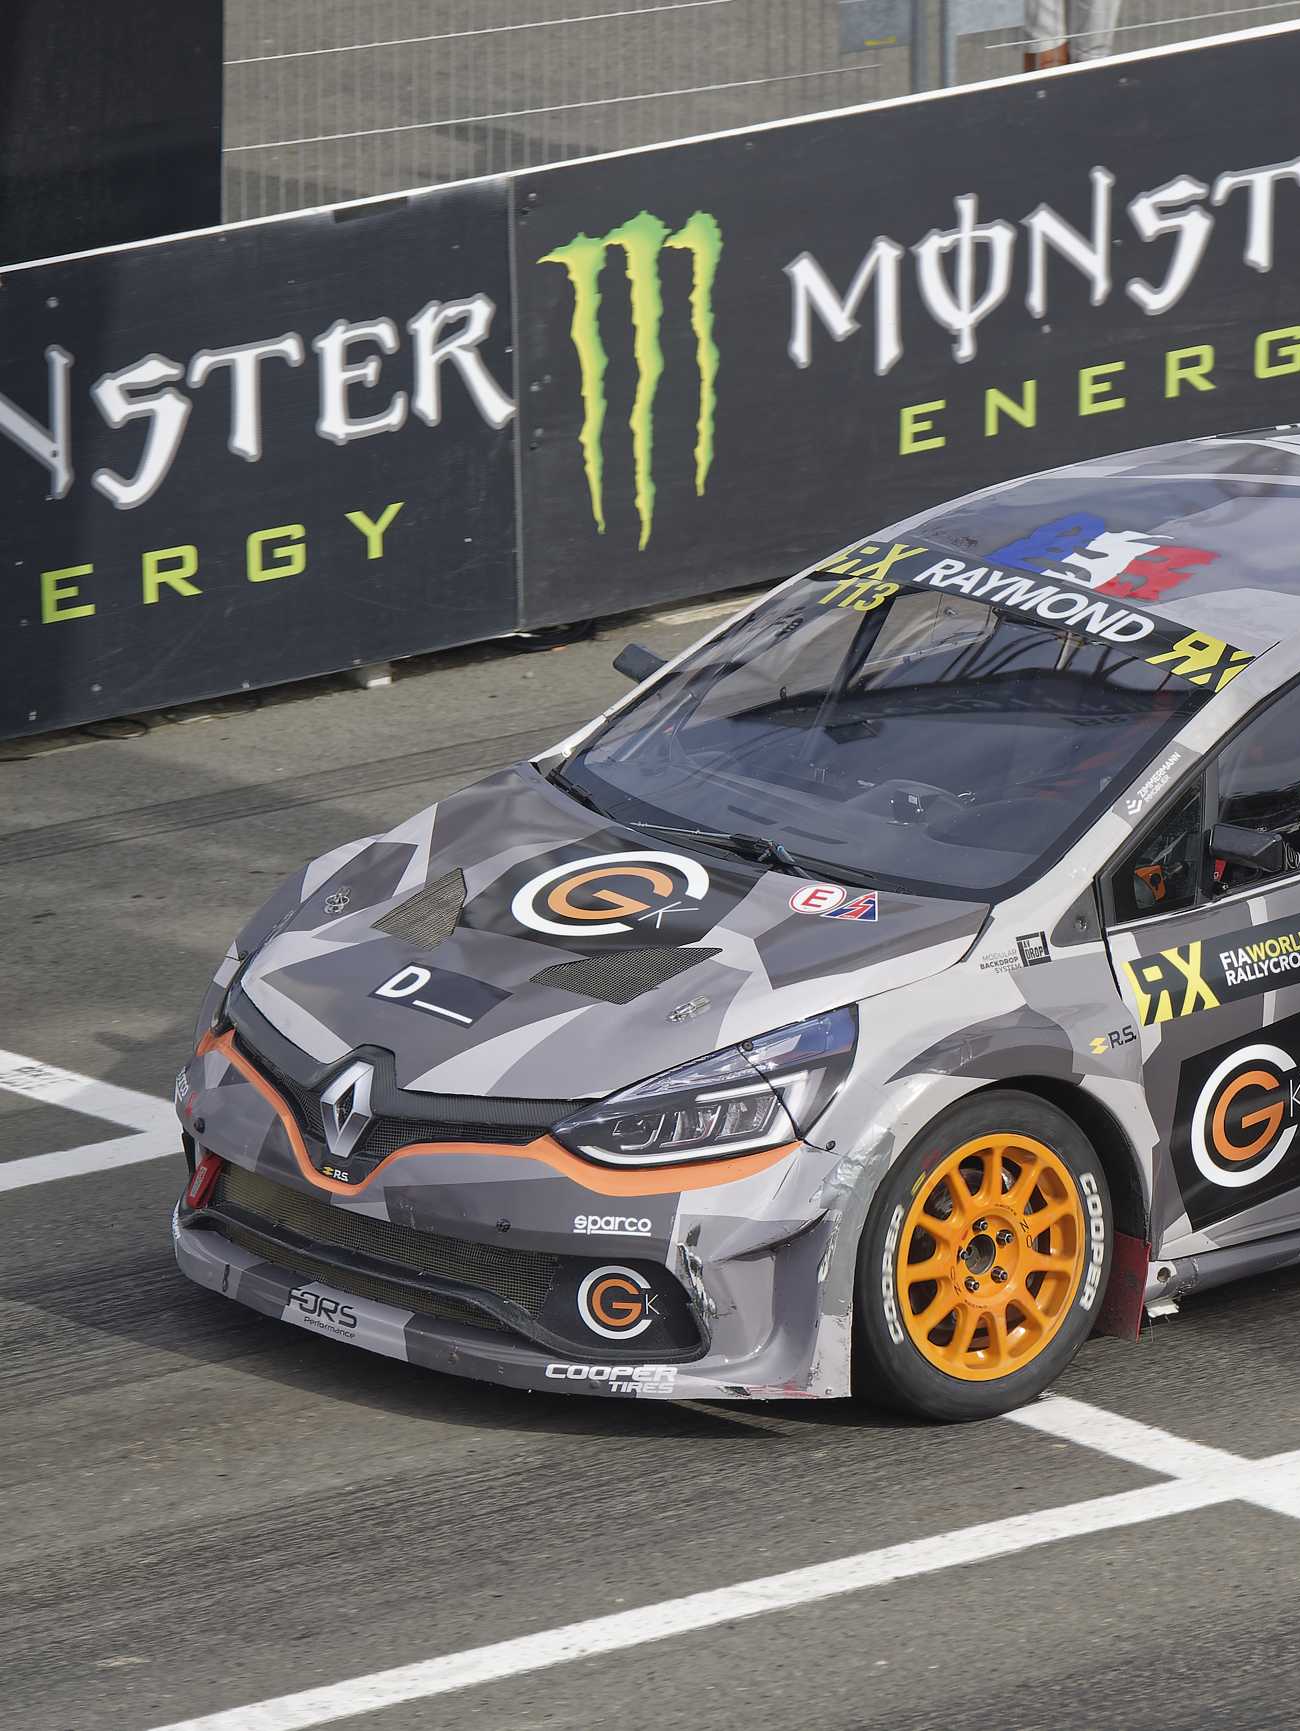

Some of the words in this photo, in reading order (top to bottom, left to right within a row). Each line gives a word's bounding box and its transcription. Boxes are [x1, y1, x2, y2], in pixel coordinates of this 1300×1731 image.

[40, 502, 404, 624] ERGY
[816, 577, 900, 612] 113
[912, 558, 1155, 643] RAYMOND
[573, 1214, 652, 1237] sparco
[1079, 1172, 1104, 1311] COOPER
[303, 1316, 356, 1338] Performance
[545, 1363, 679, 1383] COOPER
[608, 1380, 675, 1394] TIRES
